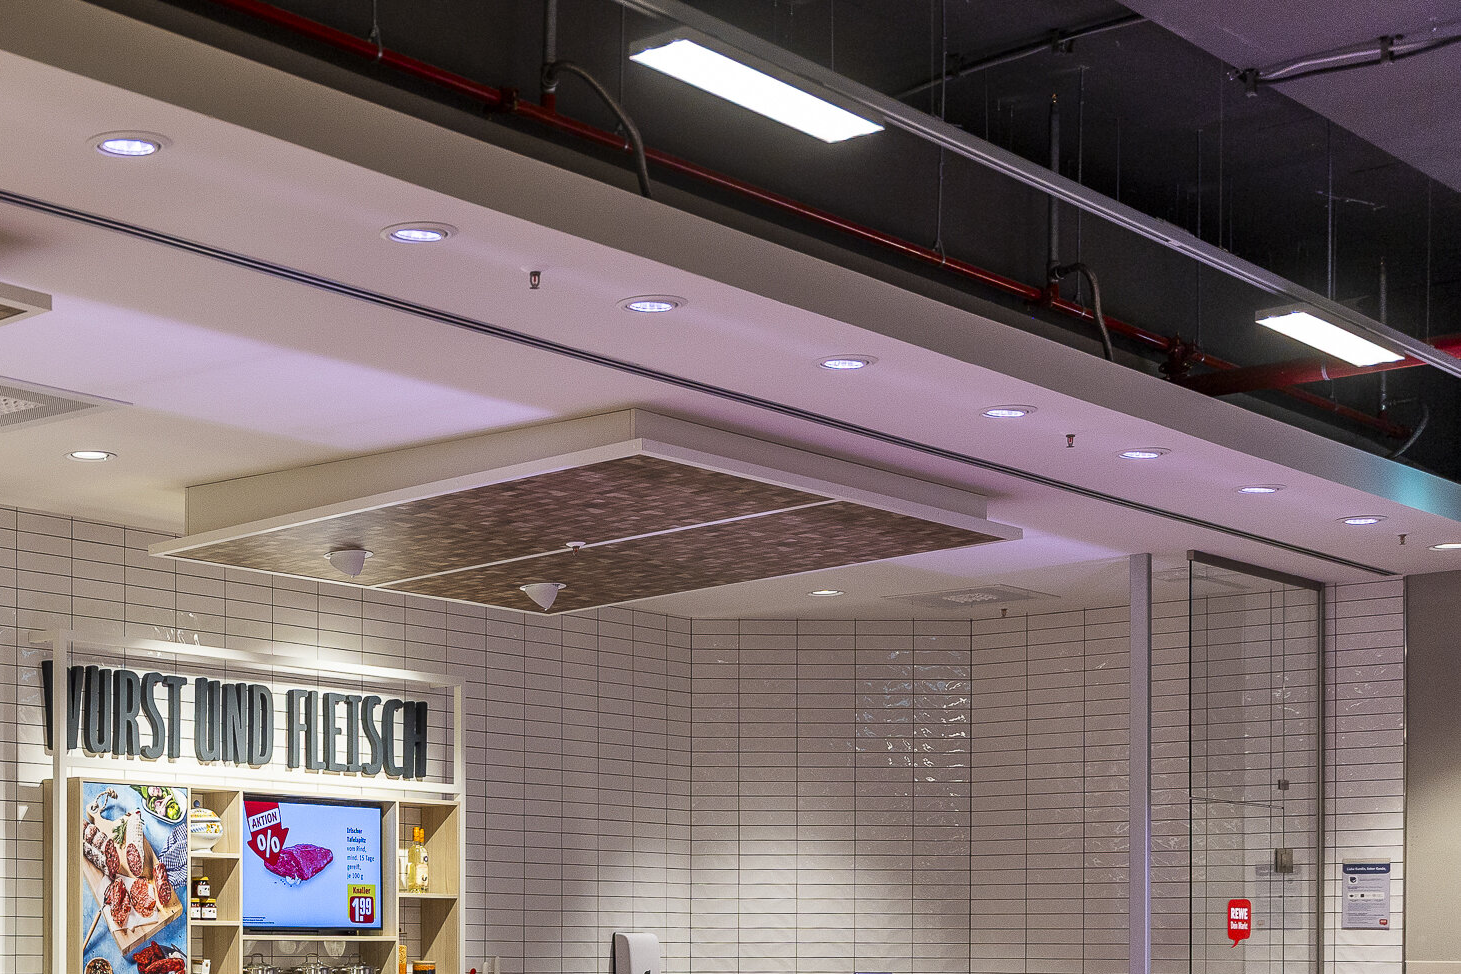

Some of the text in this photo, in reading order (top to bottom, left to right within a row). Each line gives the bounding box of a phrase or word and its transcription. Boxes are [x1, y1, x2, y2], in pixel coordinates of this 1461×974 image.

[41, 659, 428, 780] WURST UND FLEISCH
[252, 811, 278, 829] AKTION
[365, 855, 375, 863] Tage
[352, 886, 371, 894] Knaller
[351, 897, 372, 922] 1.99
[1230, 907, 1248, 920] REWE
